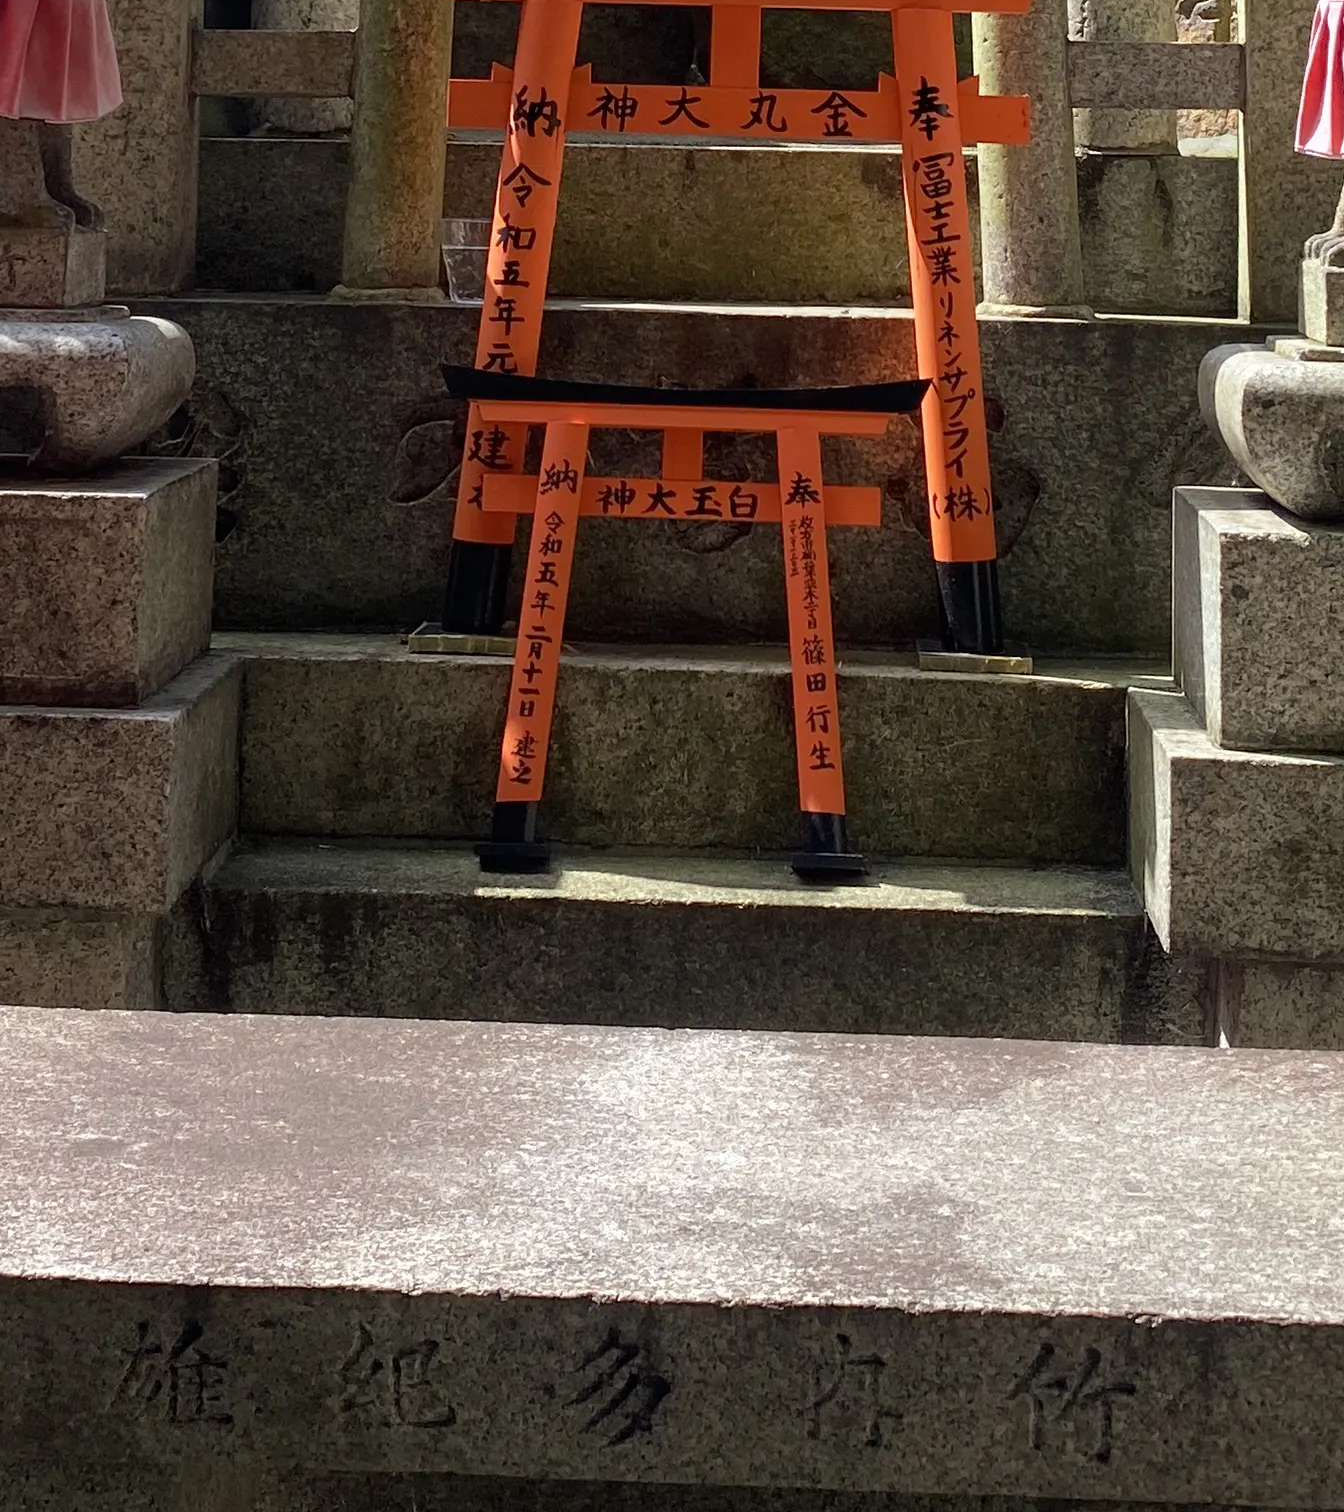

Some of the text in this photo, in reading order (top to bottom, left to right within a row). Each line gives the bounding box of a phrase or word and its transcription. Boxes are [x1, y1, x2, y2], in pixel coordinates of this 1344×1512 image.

[508, 84, 563, 138] 納
[909, 75, 955, 142] 奉
[539, 458, 579, 497] 納
[784, 471, 822, 509] 奉
